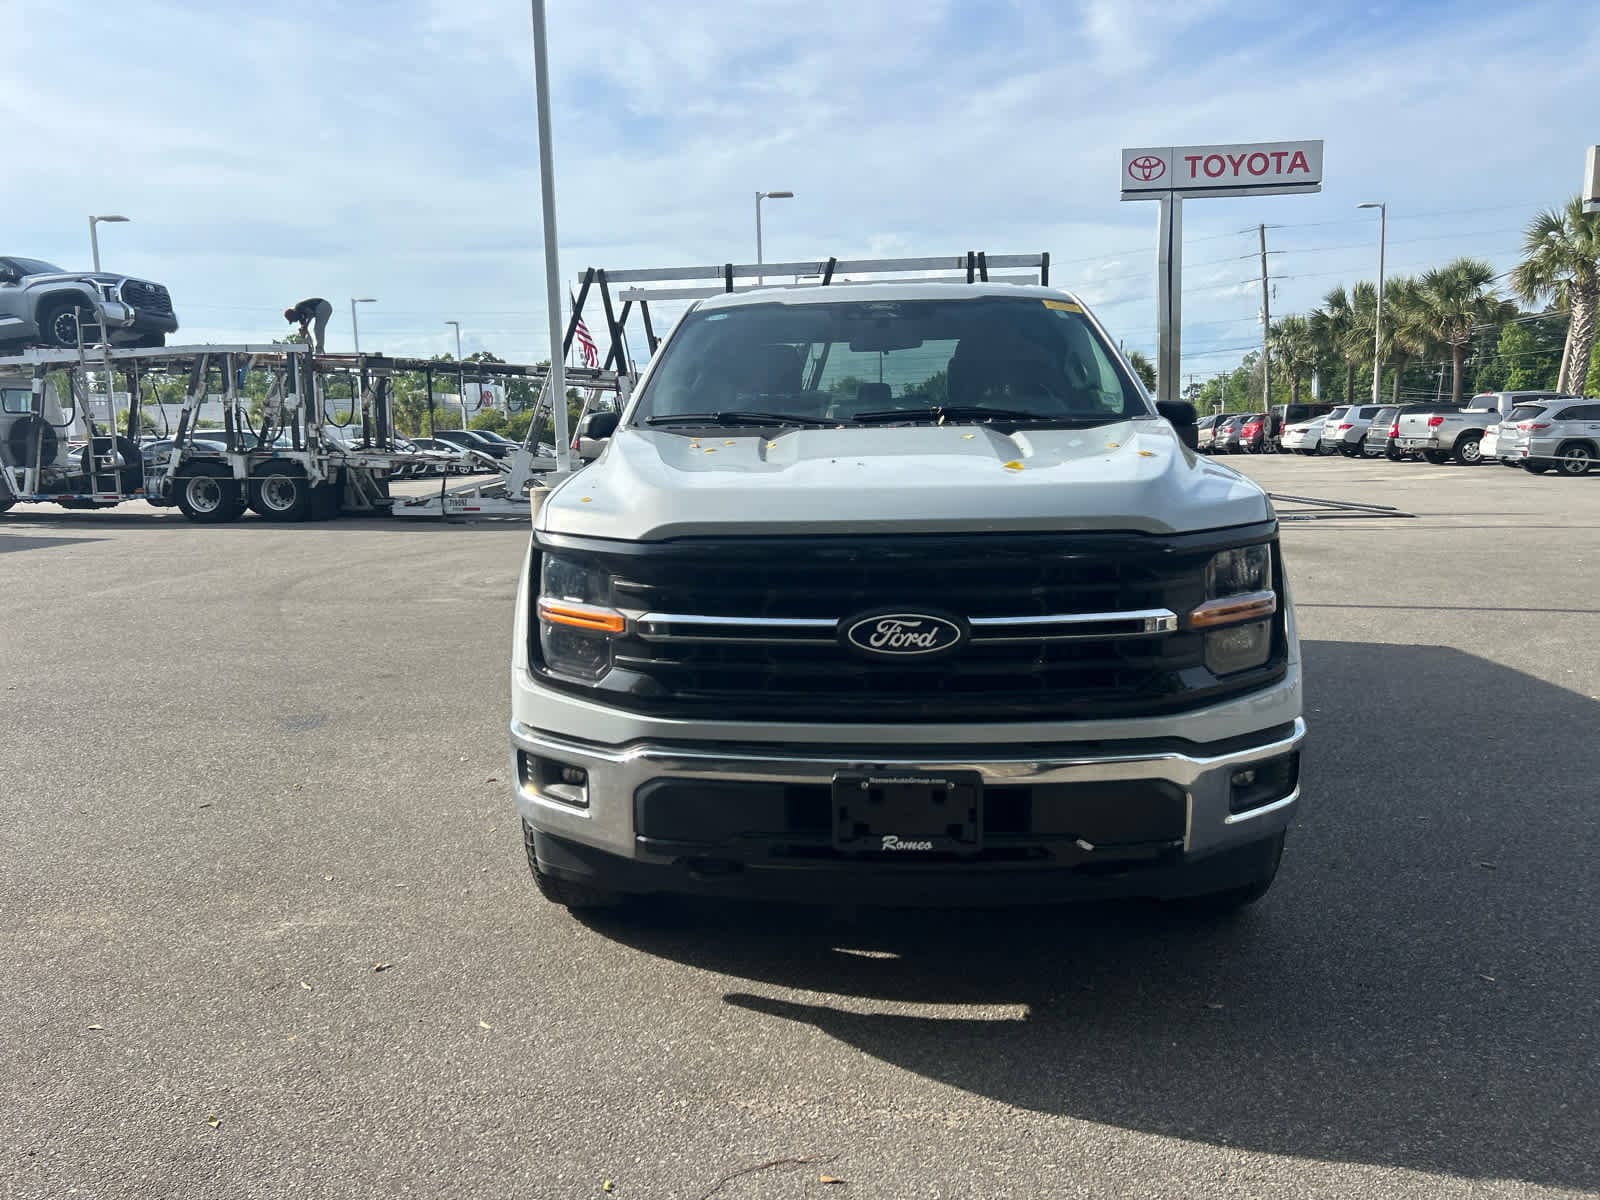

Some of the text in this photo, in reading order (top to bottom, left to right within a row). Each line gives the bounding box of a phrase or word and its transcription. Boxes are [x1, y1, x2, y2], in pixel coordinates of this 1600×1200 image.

[1184, 150, 1310, 178] TOYOTA
[869, 619, 939, 647] Ford
[881, 835, 933, 851] Romeo
